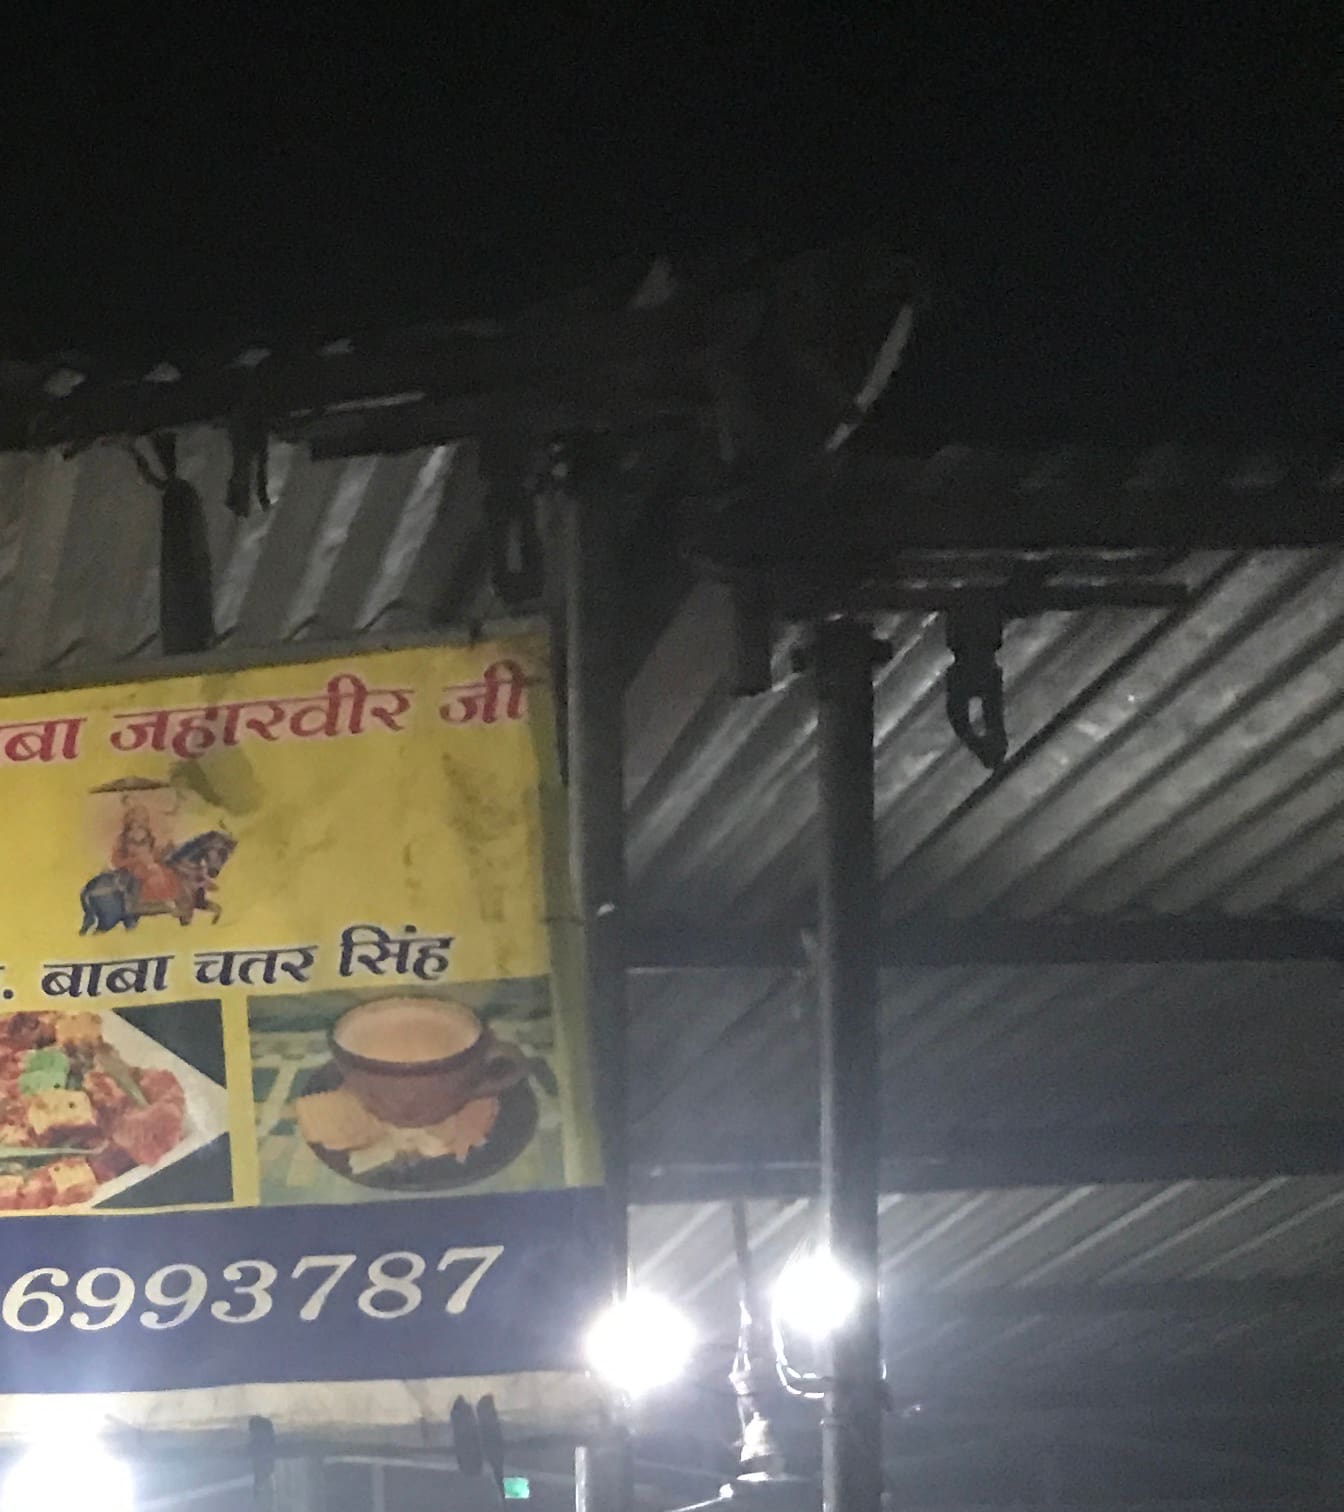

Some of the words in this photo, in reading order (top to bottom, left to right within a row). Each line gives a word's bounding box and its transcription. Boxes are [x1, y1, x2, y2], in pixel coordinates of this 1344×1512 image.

[109, 674, 415, 760] जहारवीर
[438, 660, 533, 727] जी
[41, 954, 174, 999] बाबा
[194, 944, 318, 988] चतर
[338, 923, 455, 982] सिंह
